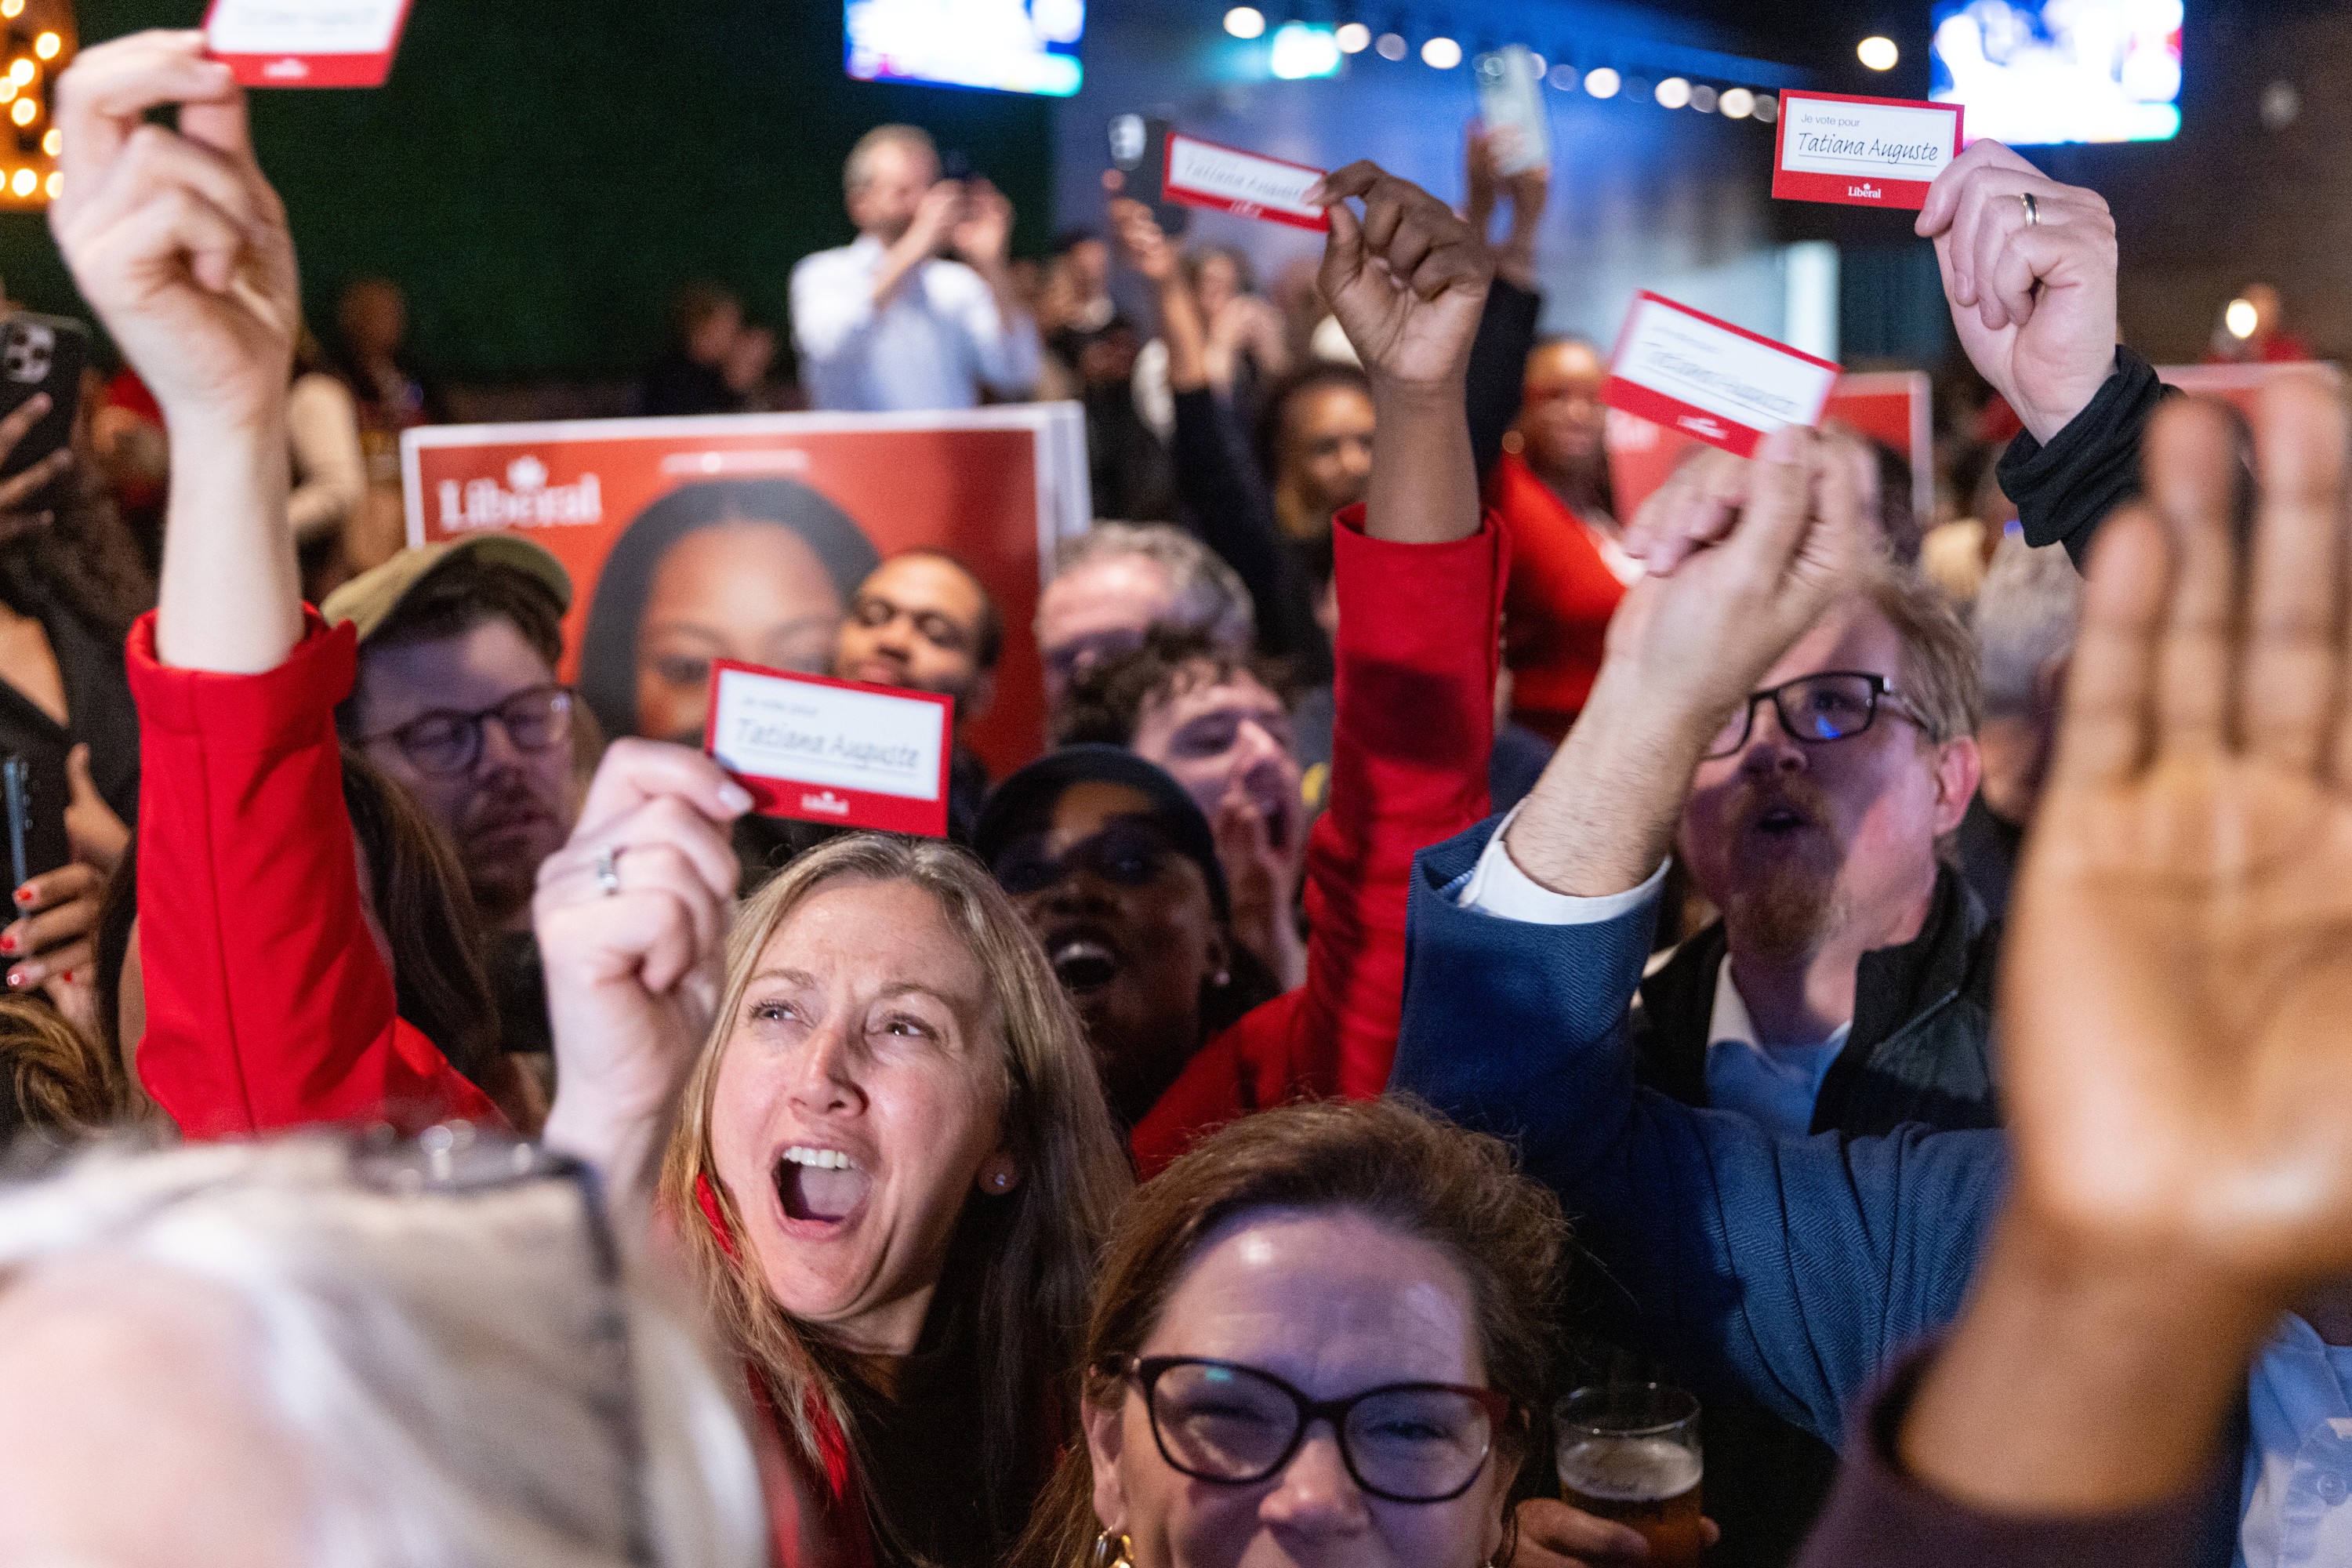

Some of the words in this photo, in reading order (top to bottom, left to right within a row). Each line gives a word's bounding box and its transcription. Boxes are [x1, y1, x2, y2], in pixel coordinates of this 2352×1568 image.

[1801, 114, 1813, 123] Je
[1815, 116, 1836, 125] vote
[1838, 118, 1860, 128] pour
[1798, 132, 1865, 155] Tatiana
[1868, 139, 1938, 164] Auguste
